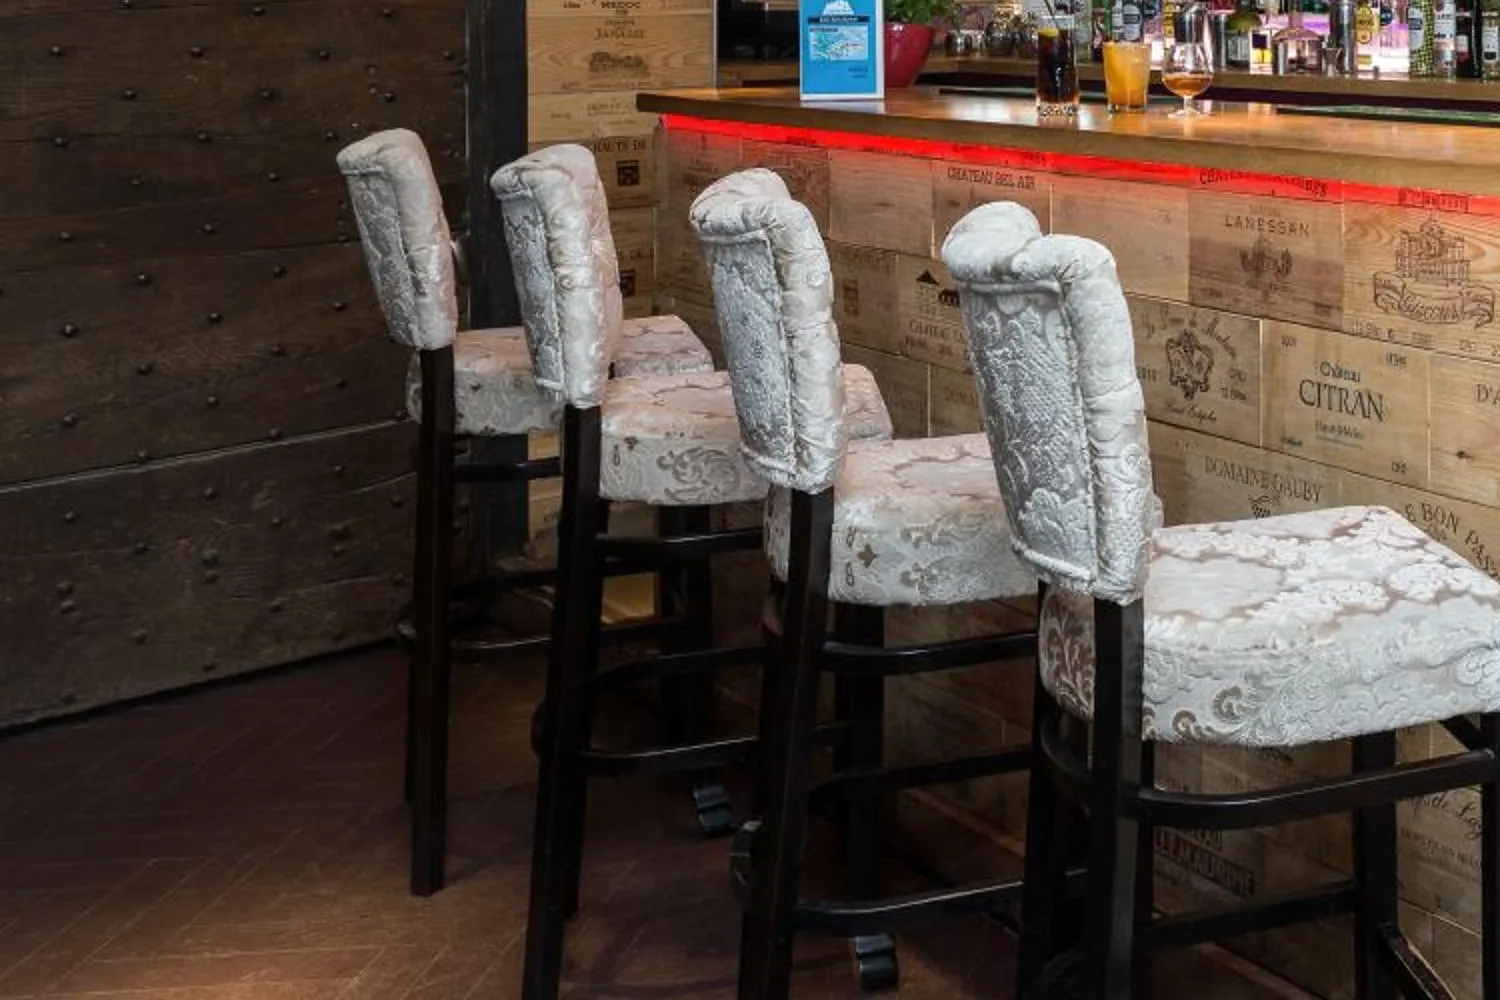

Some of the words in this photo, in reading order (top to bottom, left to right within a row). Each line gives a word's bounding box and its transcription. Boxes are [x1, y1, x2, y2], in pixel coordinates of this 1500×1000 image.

[1222, 213, 1311, 239] LANESSAN
[1298, 378, 1386, 423] CITRAN
[1204, 454, 1270, 490] DOMAINE
[1271, 471, 1324, 506] GAUBY
[1420, 502, 1460, 535] BON
